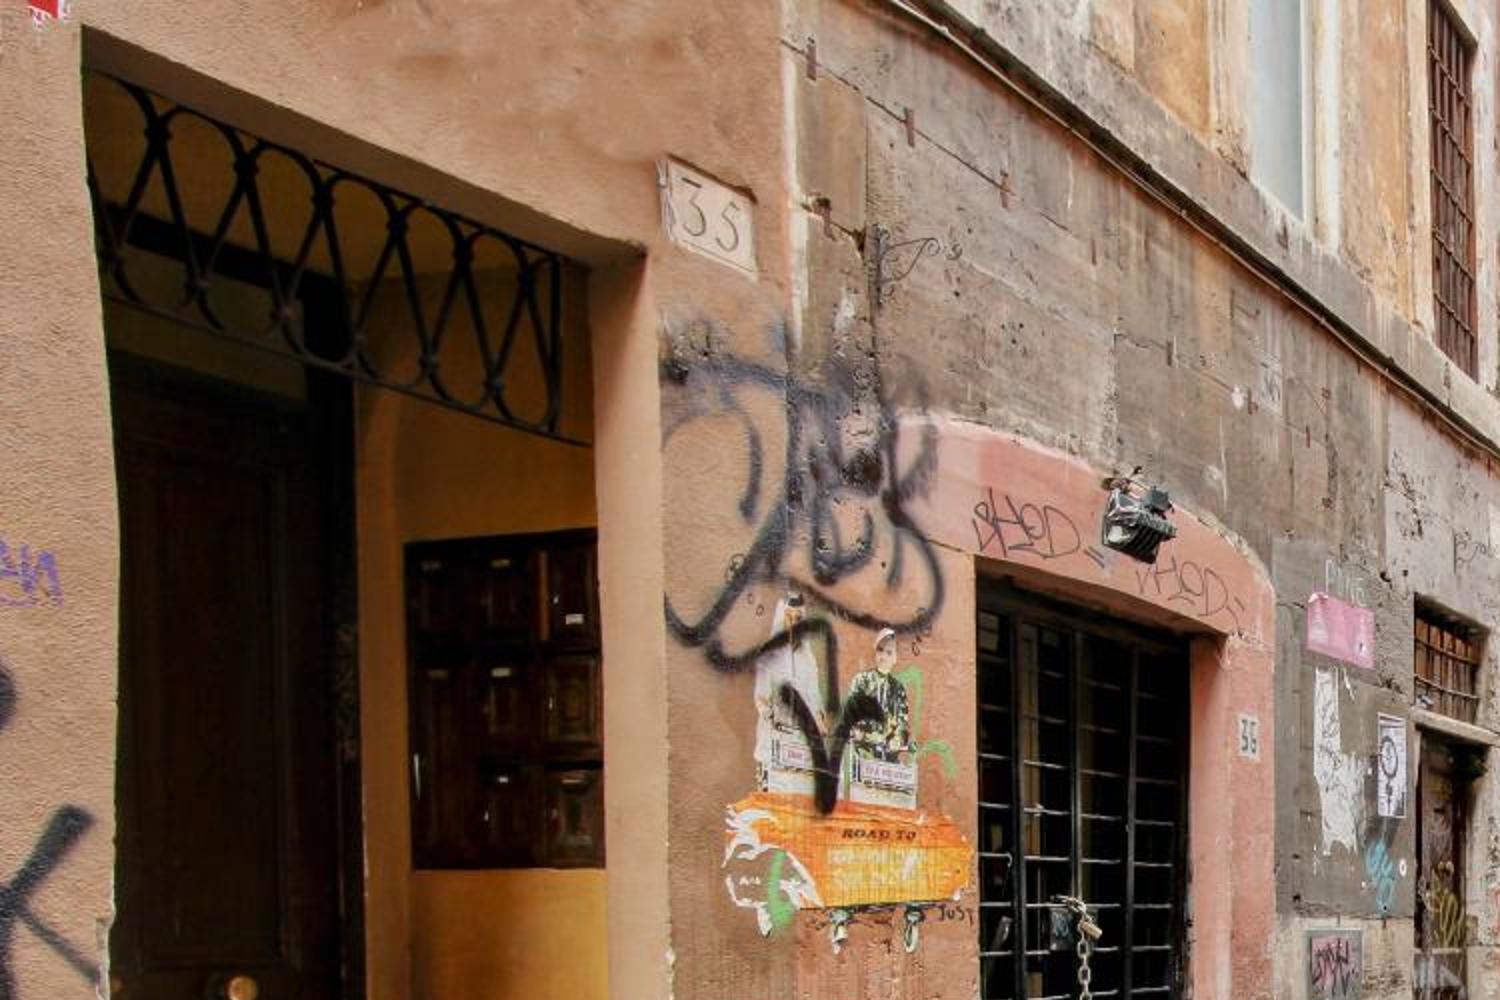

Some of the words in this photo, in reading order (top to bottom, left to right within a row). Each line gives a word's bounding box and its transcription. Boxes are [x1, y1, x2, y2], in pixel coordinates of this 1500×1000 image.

[680, 176, 740, 253] 35
[841, 828, 890, 841] ROAD
[896, 830, 917, 841] TO
